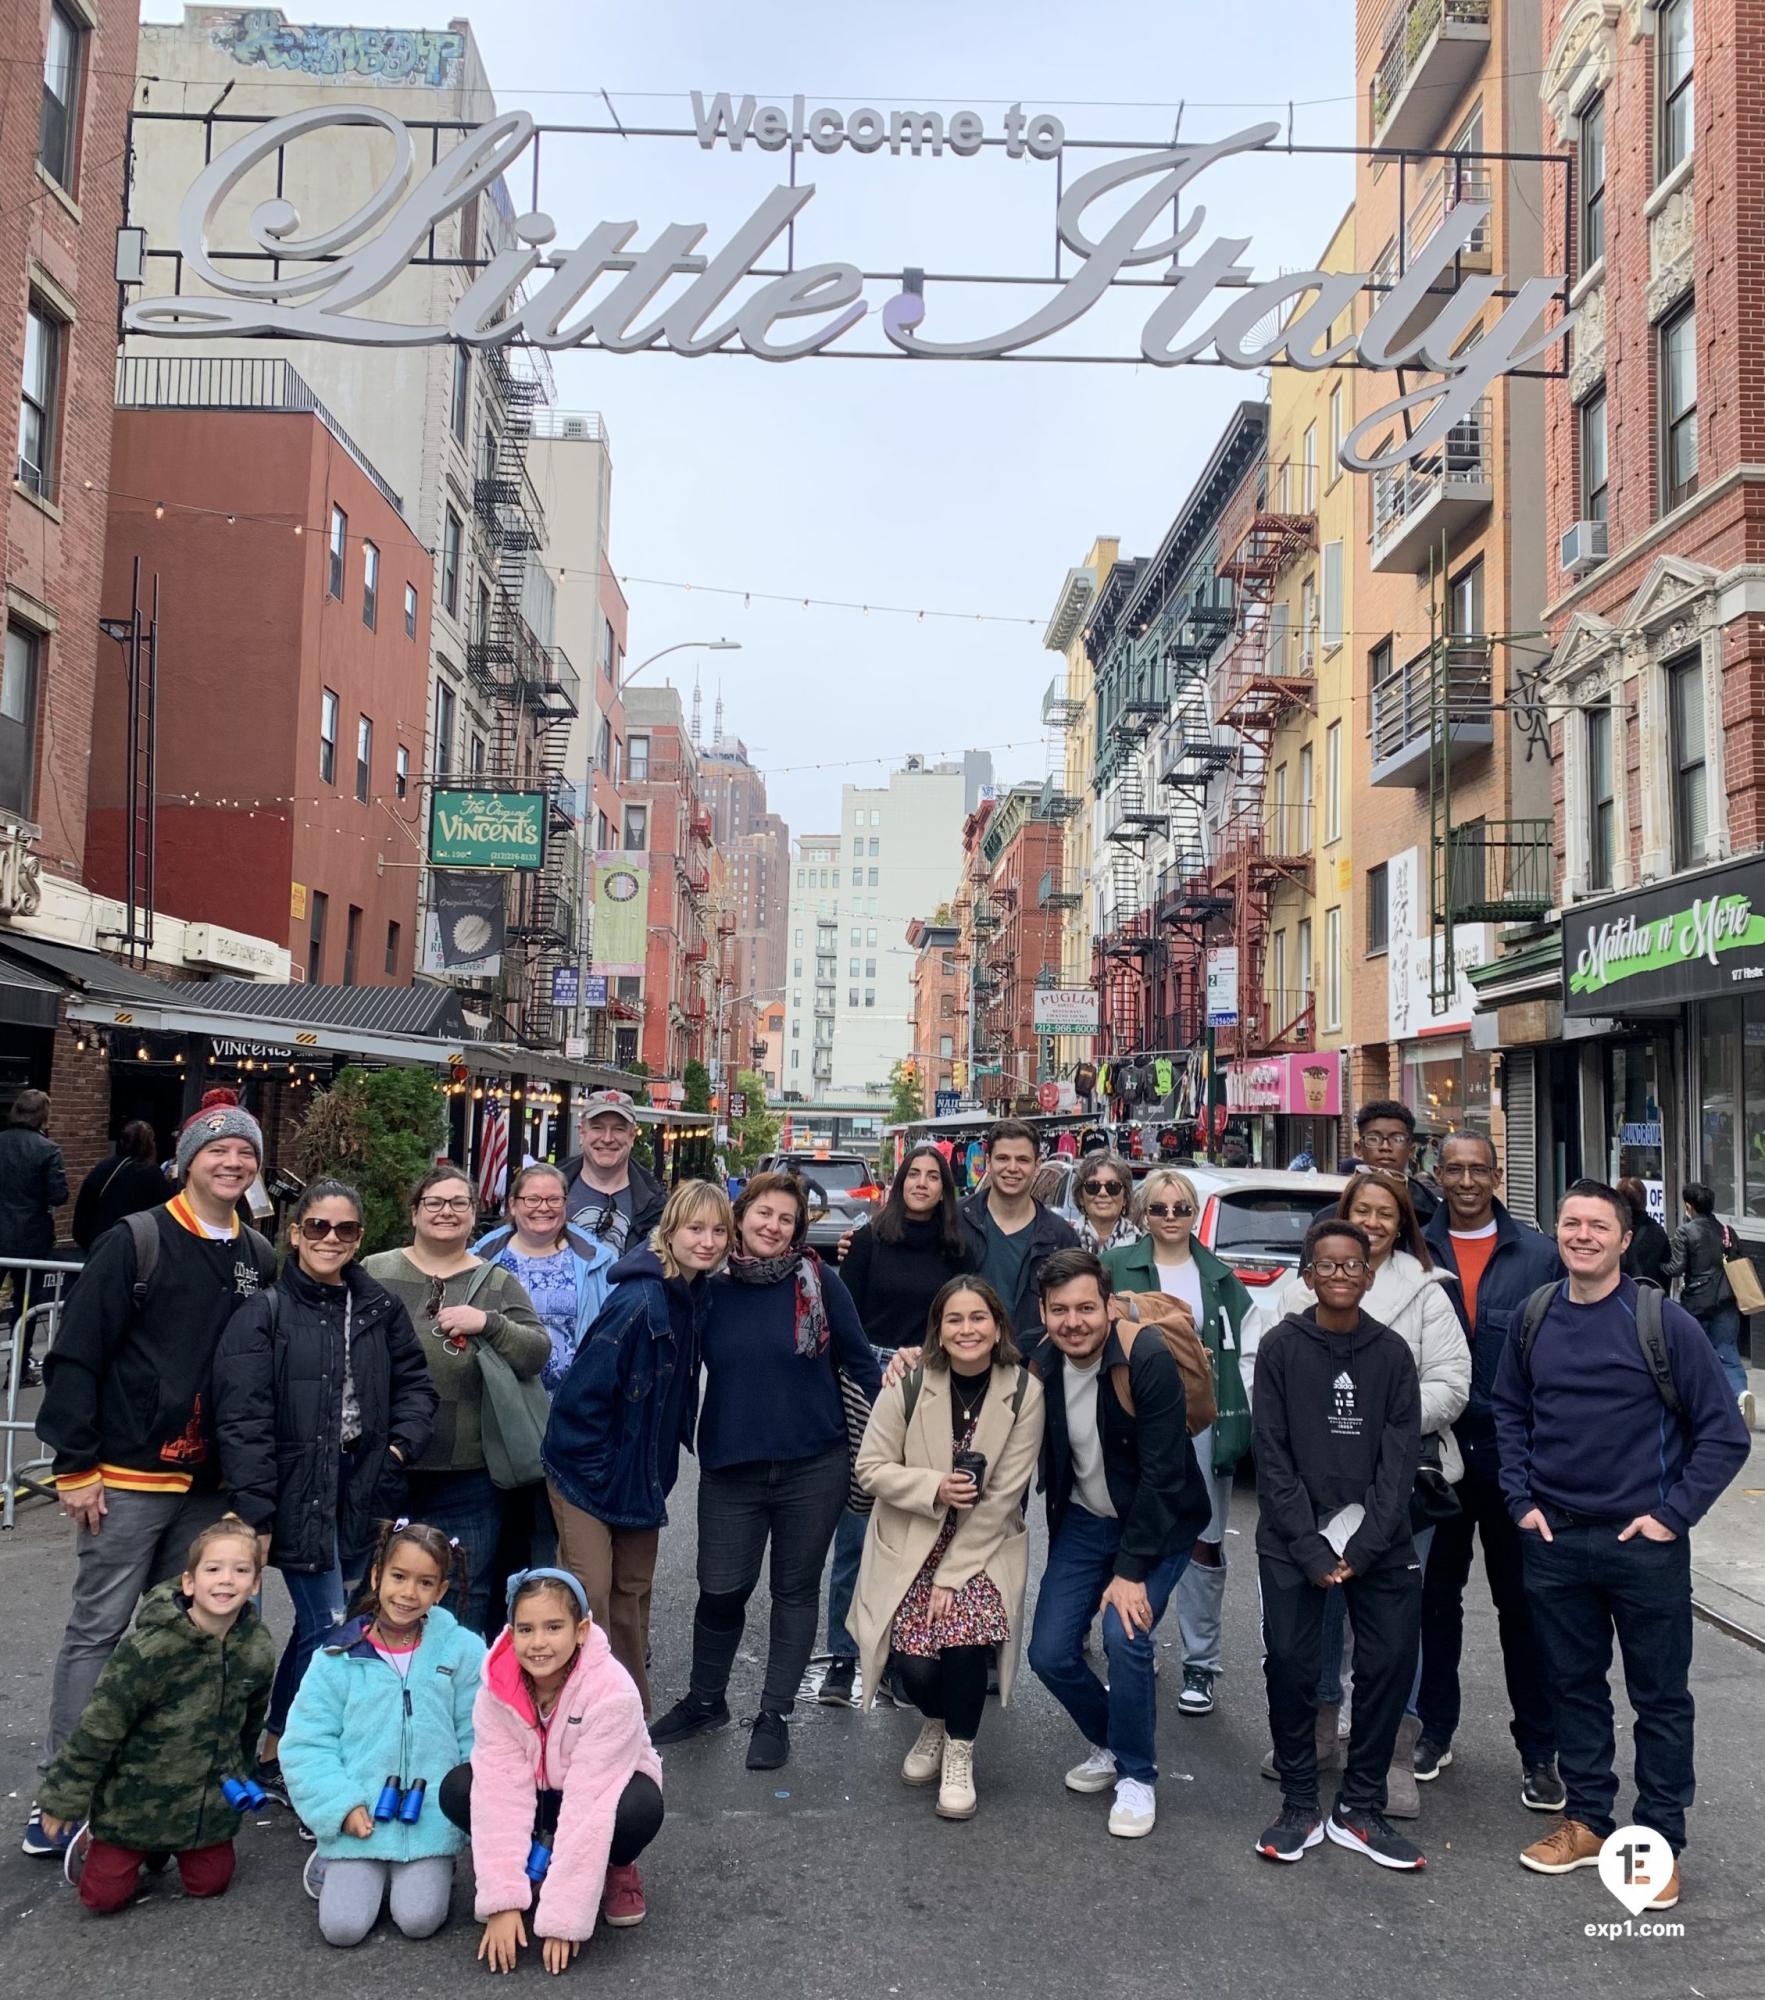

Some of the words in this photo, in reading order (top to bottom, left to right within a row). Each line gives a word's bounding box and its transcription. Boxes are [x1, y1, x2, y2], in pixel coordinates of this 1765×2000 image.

[690, 90, 984, 157] Welcome
[1003, 102, 1065, 160] to
[123, 104, 867, 363] Little
[884, 122, 1578, 473] Italy
[460, 800, 485, 815] The
[486, 801, 535, 823] Original
[1578, 914, 1653, 984] Matcha
[1679, 895, 1752, 966] More
[1041, 992, 1095, 1007] PUGLIA
[1037, 1024, 1098, 1033] 212-966-6006
